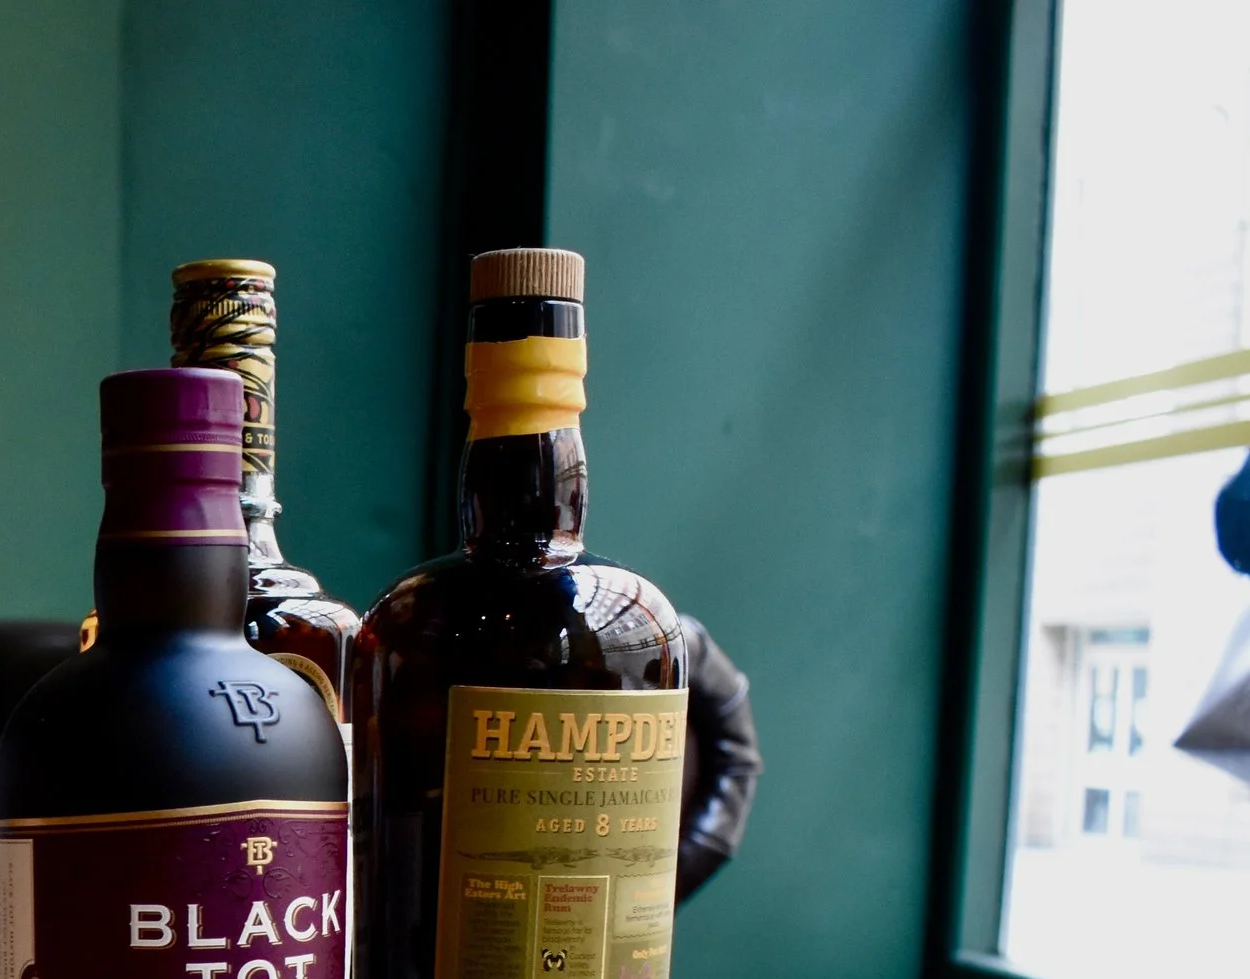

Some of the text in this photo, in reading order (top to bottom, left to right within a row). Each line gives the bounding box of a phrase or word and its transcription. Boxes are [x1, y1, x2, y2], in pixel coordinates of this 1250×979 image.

[572, 766, 639, 783] ESTATE
[470, 788, 520, 804] PURE
[526, 789, 596, 807] SINGLE
[535, 813, 658, 837] AGED 8 YEARS
[469, 878, 523, 891] The High
[544, 883, 599, 894] Trelawny
[504, 888, 527, 899] Art
[544, 893, 593, 903] Endemic
[544, 902, 571, 912] Rum
[129, 890, 342, 949] BLACK
